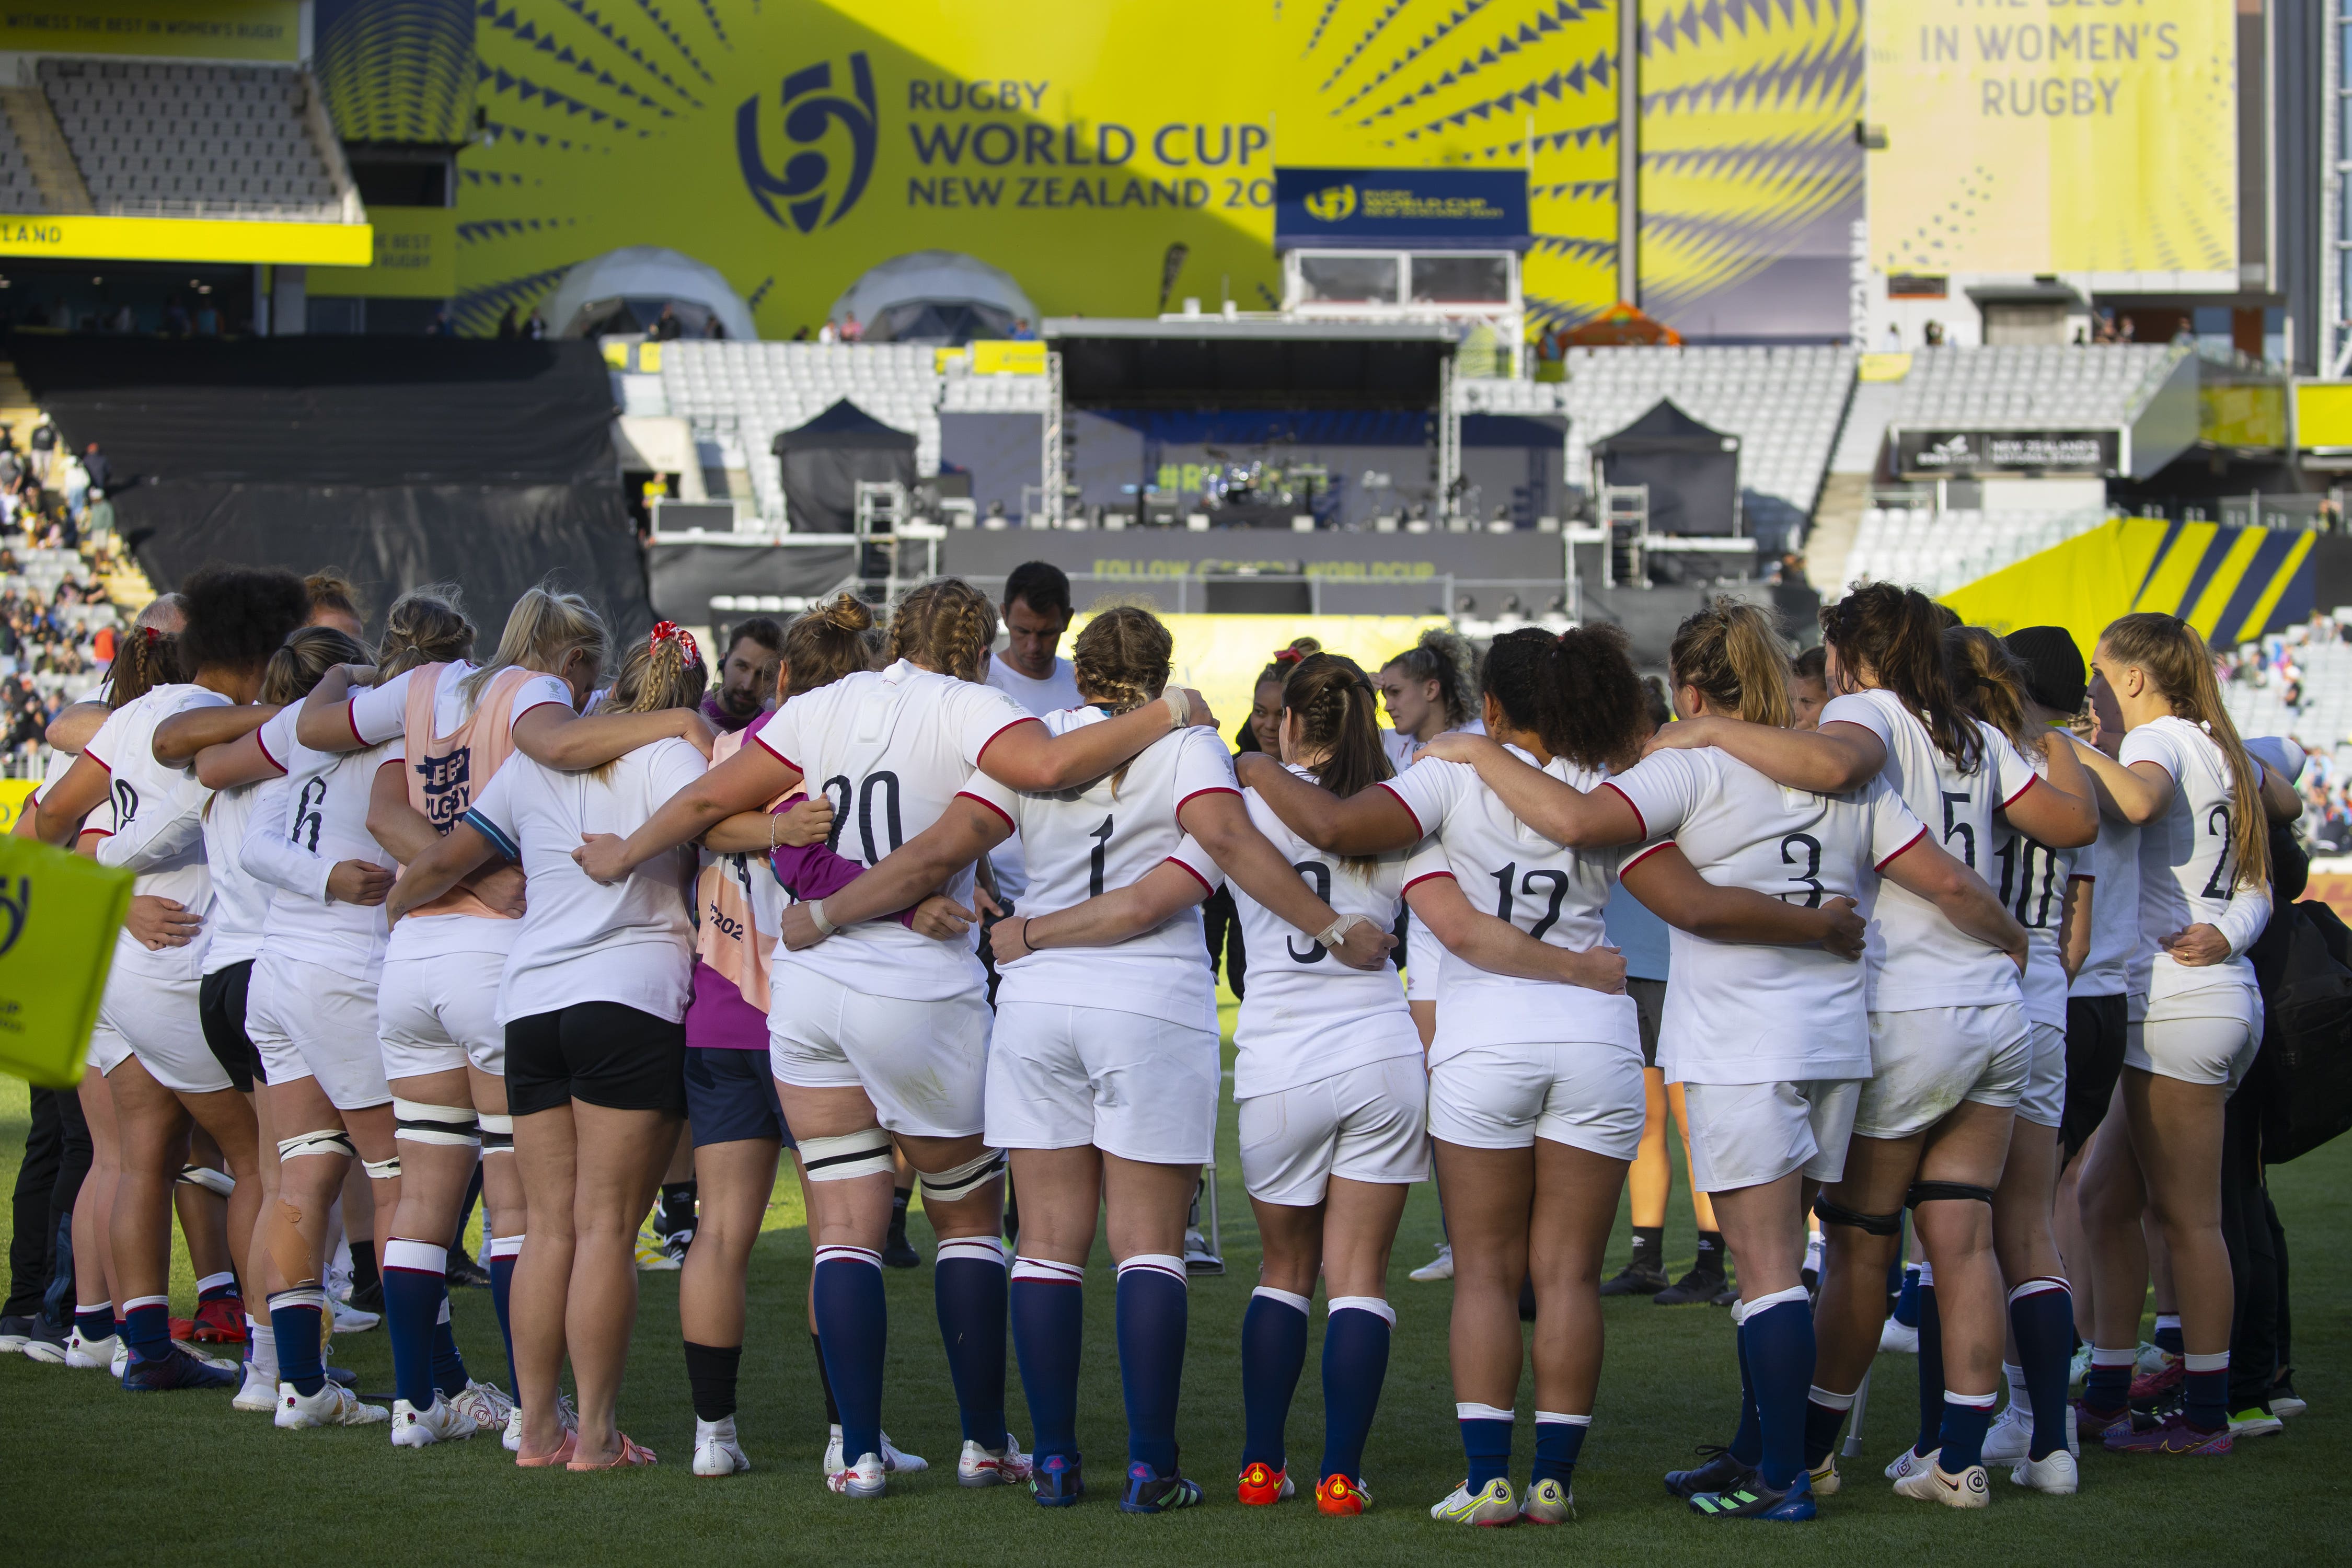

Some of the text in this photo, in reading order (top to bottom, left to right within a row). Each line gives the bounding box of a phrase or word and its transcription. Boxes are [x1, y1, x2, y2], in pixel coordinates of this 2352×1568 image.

[75, 16, 100, 32] THE
[106, 16, 143, 33] BEST
[1920, 22, 2180, 62] IN WOMEN'S
[908, 79, 1049, 112] RUGBY
[1981, 77, 2121, 117] RUGBY
[908, 122, 1269, 166] WORLD CUP
[908, 178, 1007, 209] NEW
[1017, 178, 1211, 209] ZEALAND
[0, 224, 61, 243] LAND
[292, 776, 327, 854] 6
[822, 770, 903, 866] 20
[1942, 790, 1976, 870] 5
[1089, 814, 1114, 898] 1
[1781, 833, 1824, 909] 3
[1994, 834, 2057, 929] 10
[1490, 861, 1570, 951] 12
